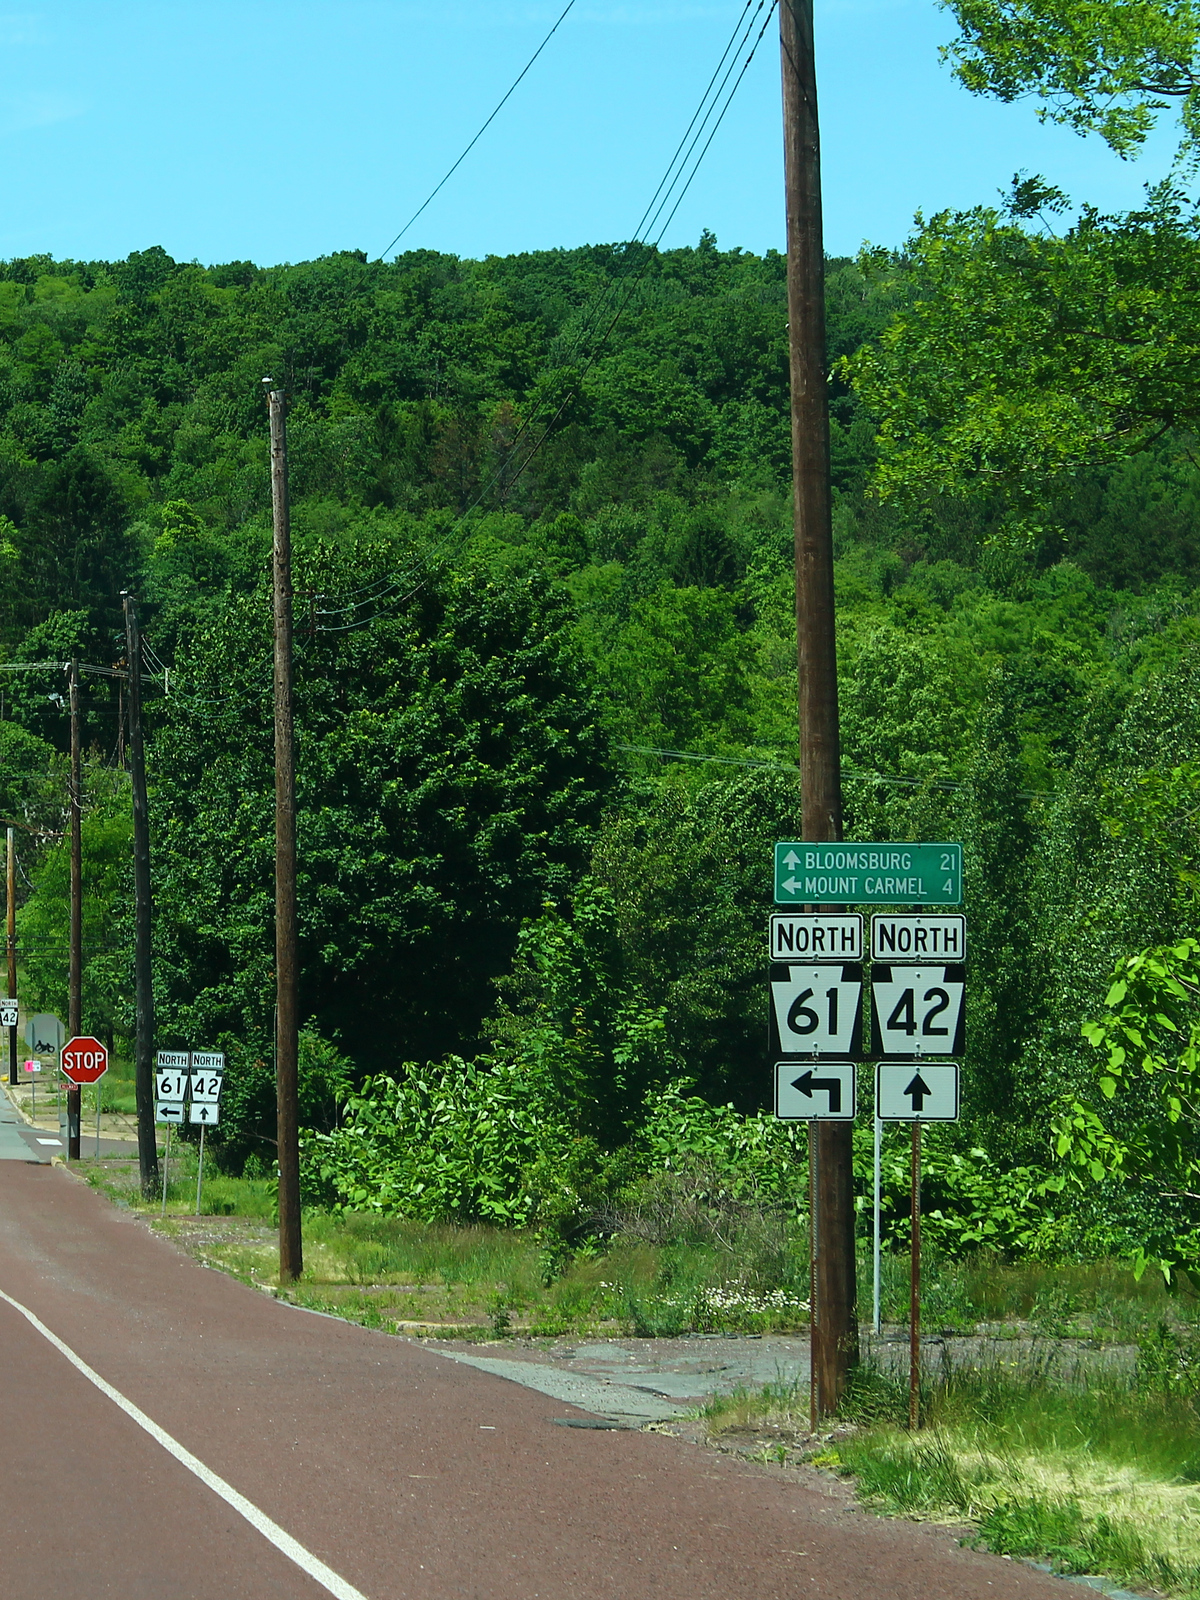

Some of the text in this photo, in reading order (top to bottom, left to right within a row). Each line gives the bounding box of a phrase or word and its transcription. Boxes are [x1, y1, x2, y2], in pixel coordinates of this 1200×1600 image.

[805, 852, 956, 870] BLOOMSBURG 21
[805, 877, 953, 895] MOUNT CARMEL 4
[777, 923, 855, 951] NORTH
[879, 923, 957, 952] NORTH
[3, 1012, 15, 1022] 42
[787, 987, 838, 1035] 61
[886, 987, 950, 1036] 42
[64, 1051, 105, 1070] STOP
[159, 1053, 187, 1066] NORTH
[193, 1054, 222, 1067] NORTH
[161, 1076, 181, 1094] 61
[194, 1077, 219, 1096] 42
